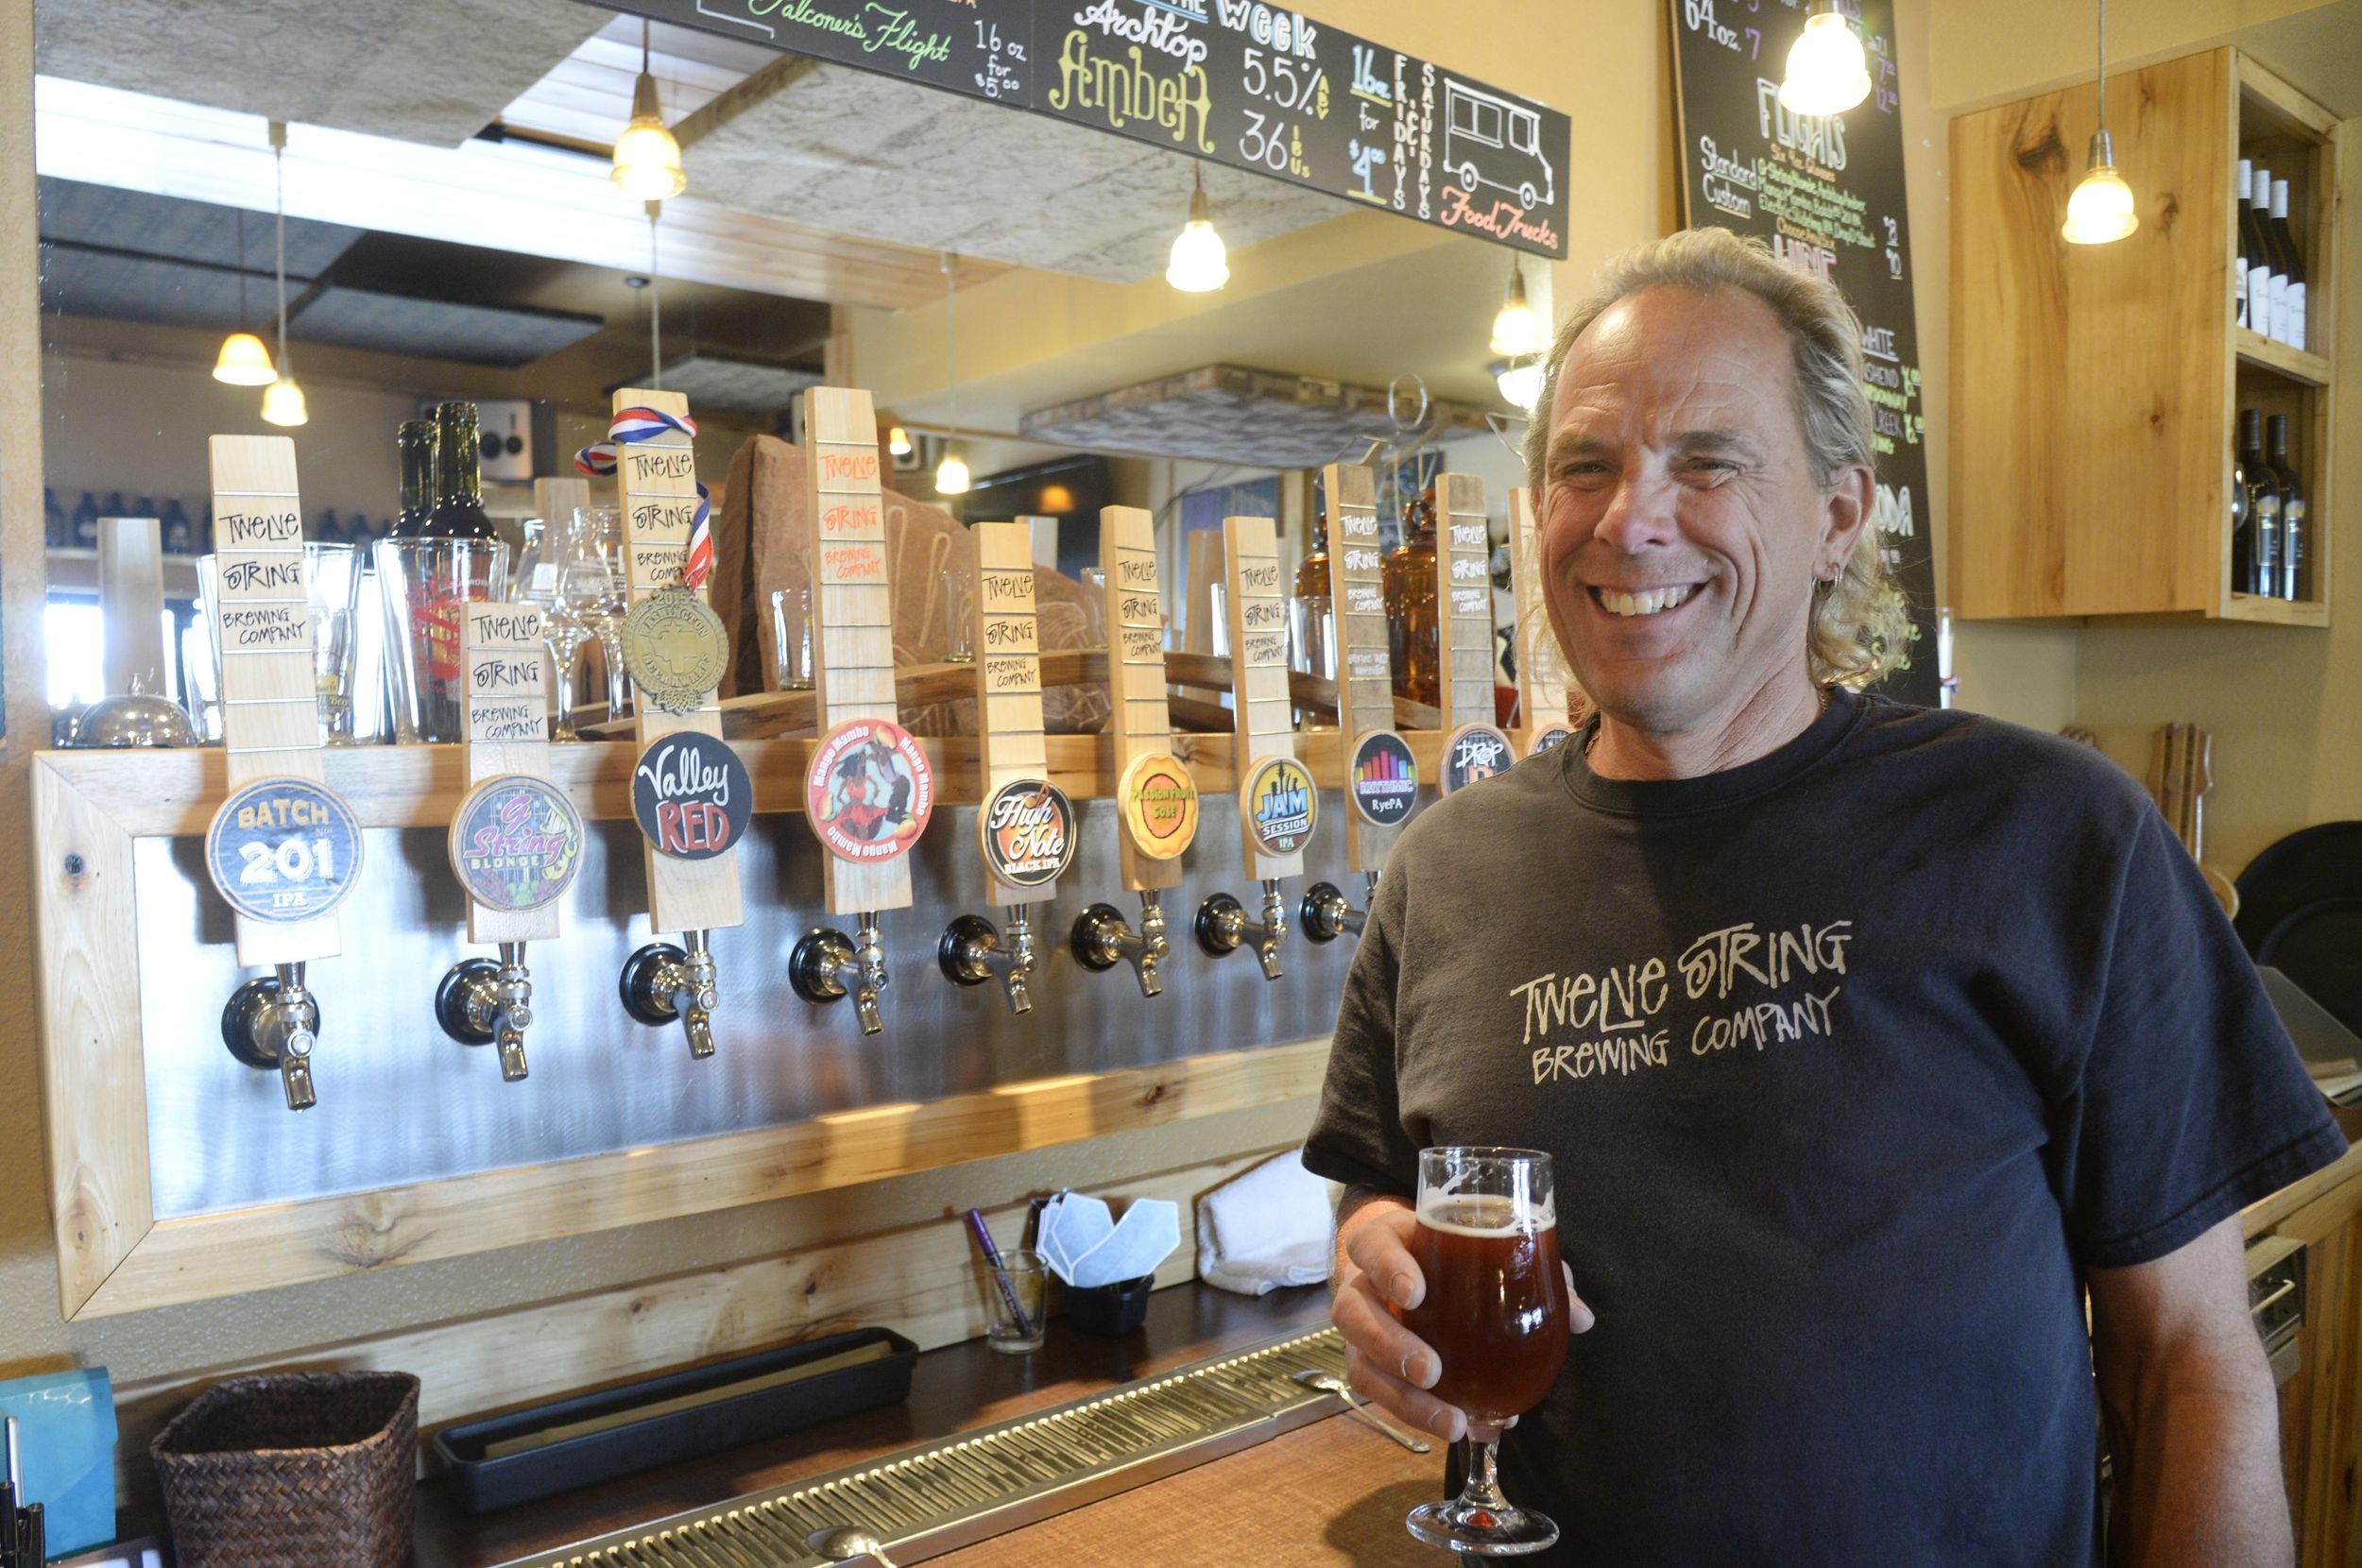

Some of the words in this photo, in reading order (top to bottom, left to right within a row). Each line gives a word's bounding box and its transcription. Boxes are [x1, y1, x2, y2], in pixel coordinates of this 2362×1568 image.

[863, 2, 950, 70] Flight
[974, 20, 1001, 52] 16
[1007, 43, 1027, 61] oz
[1073, 0, 1208, 73] Archtop
[987, 55, 1012, 77] for
[1359, 101, 1379, 131] for
[1393, 54, 1408, 211] FRIDAYS
[1239, 109, 1288, 170] 36
[1418, 63, 1435, 220] SATURDAYS
[1701, 135, 1757, 187] Standard
[1703, 172, 1751, 213] Custom
[1441, 185, 1499, 226] Food
[1495, 200, 1558, 250] Trucks
[1875, 483, 1914, 537] ODA
[650, 567, 686, 582] COMP
[239, 622, 307, 644] COMPANY
[486, 718, 542, 740] COMPANY
[638, 744, 729, 806] Valley
[813, 750, 836, 787] Mango
[831, 725, 870, 752] Mambo
[238, 799, 329, 828] BATCH
[916, 772, 931, 816] Mambo
[1256, 787, 1309, 824] JAM
[1372, 798, 1403, 813] RyePA
[655, 800, 731, 854] RED
[990, 794, 1054, 836] High
[1262, 817, 1309, 837] SESSION
[238, 838, 334, 884] 201
[463, 826, 567, 867] String
[827, 825, 863, 858] Mambo
[863, 840, 899, 857] Mango
[1009, 824, 1065, 861] Note
[1278, 837, 1295, 848] IPA
[471, 856, 539, 870] BLONDE
[272, 892, 310, 908] IPA
[1691, 986, 1840, 1056] COMPANY
